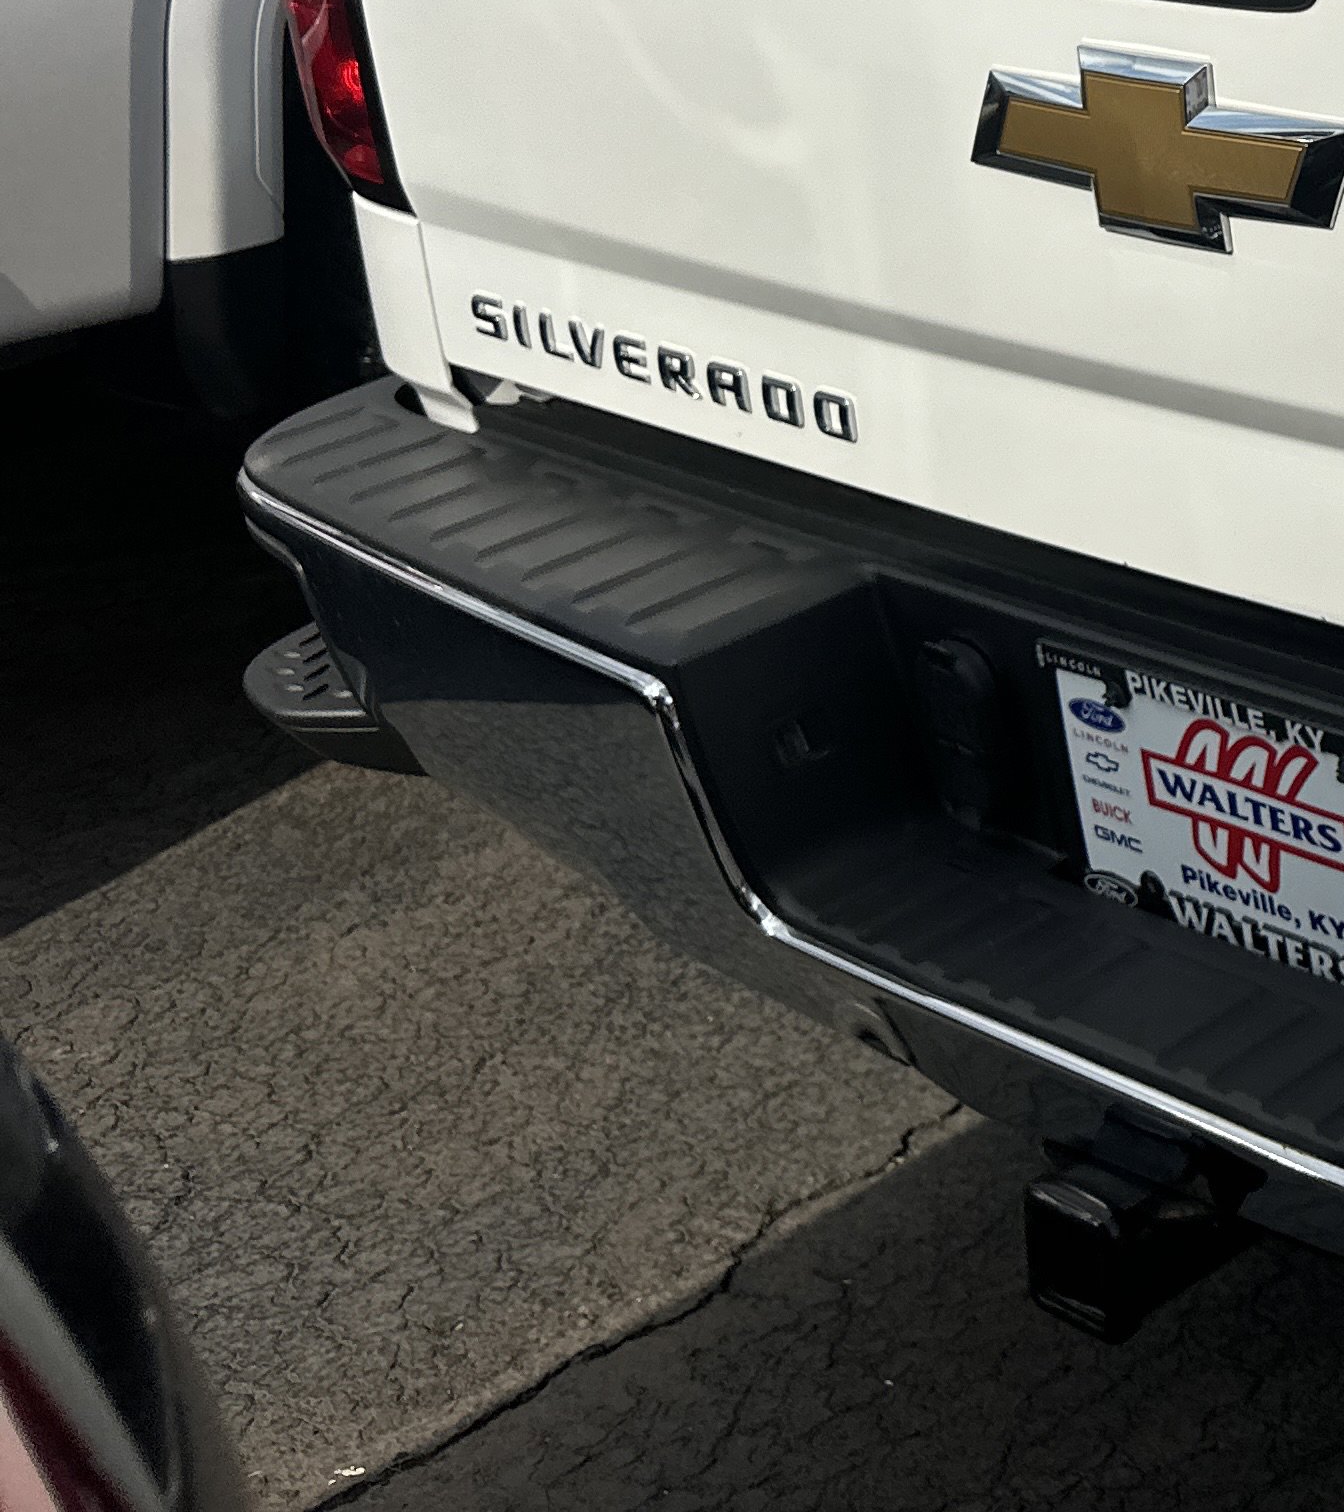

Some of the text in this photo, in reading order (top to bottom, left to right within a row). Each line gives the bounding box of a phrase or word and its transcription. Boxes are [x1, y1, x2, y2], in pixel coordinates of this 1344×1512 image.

[471, 289, 858, 443] SILVERADO
[1073, 727, 1129, 754] LINCOLN
[1125, 669, 1325, 753] PIKEVILLE, KY
[1091, 796, 1133, 824] BUICK
[1094, 824, 1143, 854] GMC
[1156, 767, 1343, 854] WALTERS
[1180, 864, 1302, 930] Pikeville,
